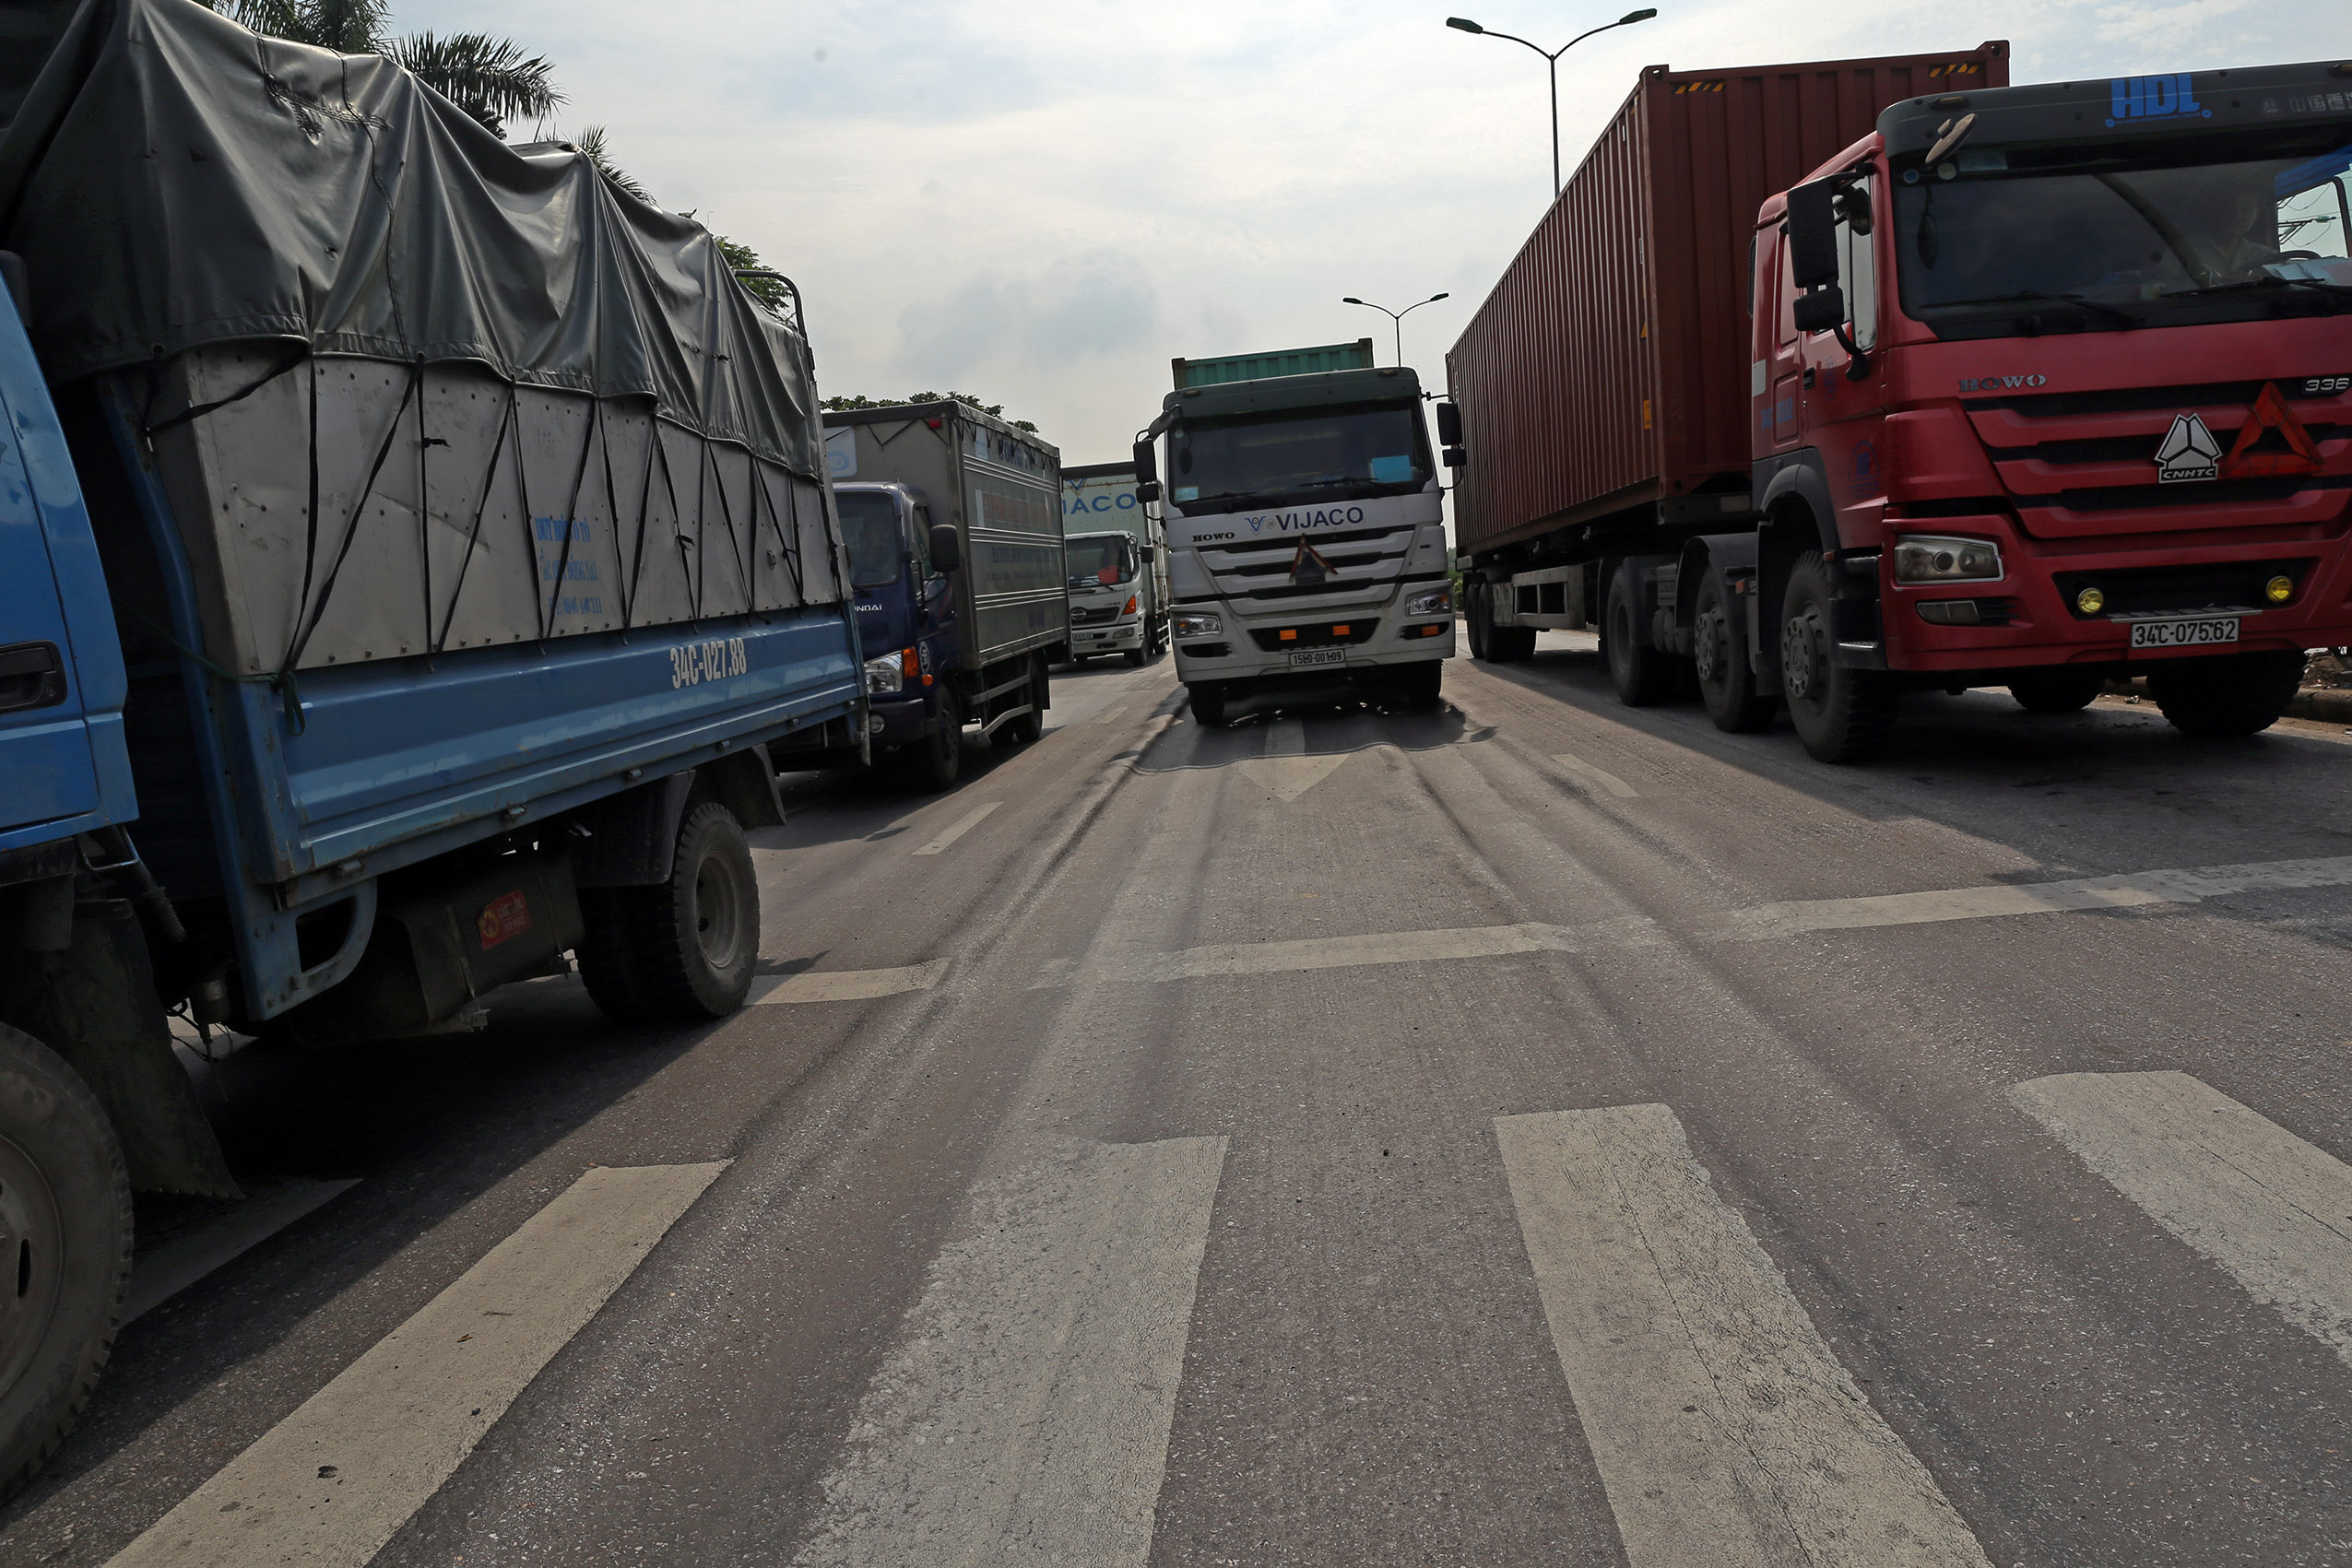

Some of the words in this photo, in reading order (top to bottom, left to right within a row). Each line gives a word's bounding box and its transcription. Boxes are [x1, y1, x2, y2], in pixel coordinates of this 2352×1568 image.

[2111, 73, 2200, 118] HDL
[1958, 374, 2047, 393] HOWO
[2305, 377, 2350, 392] 336
[2163, 468, 2215, 479] CNHTC
[1062, 493, 1137, 515] JACO
[1276, 506, 1365, 531] VIJACO
[1192, 531, 1235, 542] HOWO
[854, 604, 882, 612] NDAI
[670, 637, 747, 690] 34C-027.88
